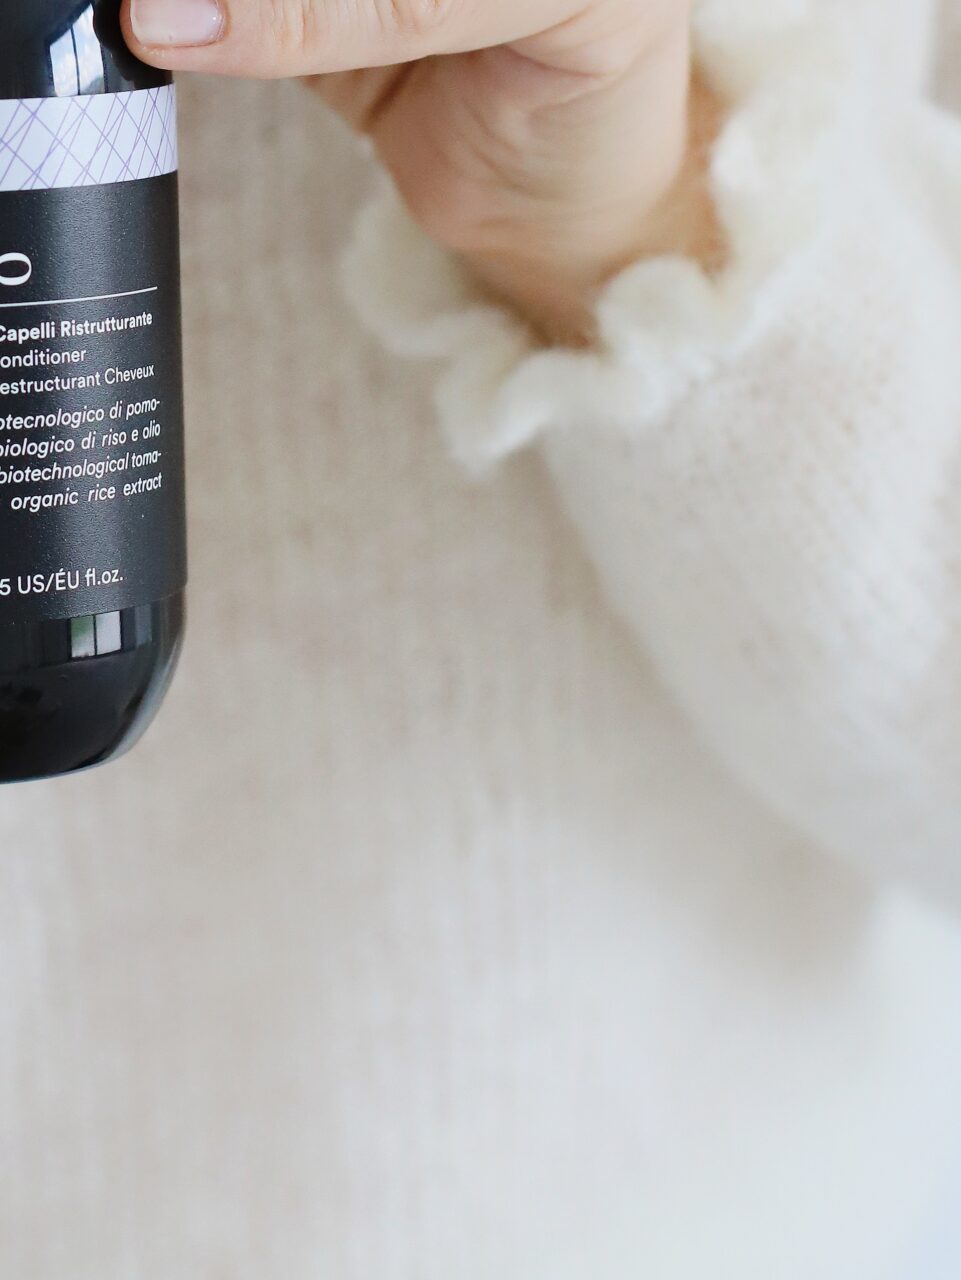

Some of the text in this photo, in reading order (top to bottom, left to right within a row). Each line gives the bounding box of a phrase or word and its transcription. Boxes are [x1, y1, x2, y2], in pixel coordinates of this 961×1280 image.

[60, 311, 153, 337] Ristrutturante
[104, 364, 155, 385] Cheveux
[109, 400, 123, 419] di
[126, 398, 160, 420] pomo-
[81, 431, 97, 450] di
[101, 428, 127, 447] riso
[131, 429, 139, 442] e
[142, 419, 161, 439] olio
[131, 450, 162, 468] toma-
[10, 487, 79, 513] organic
[88, 483, 116, 502] rice
[123, 472, 162, 497] extract
